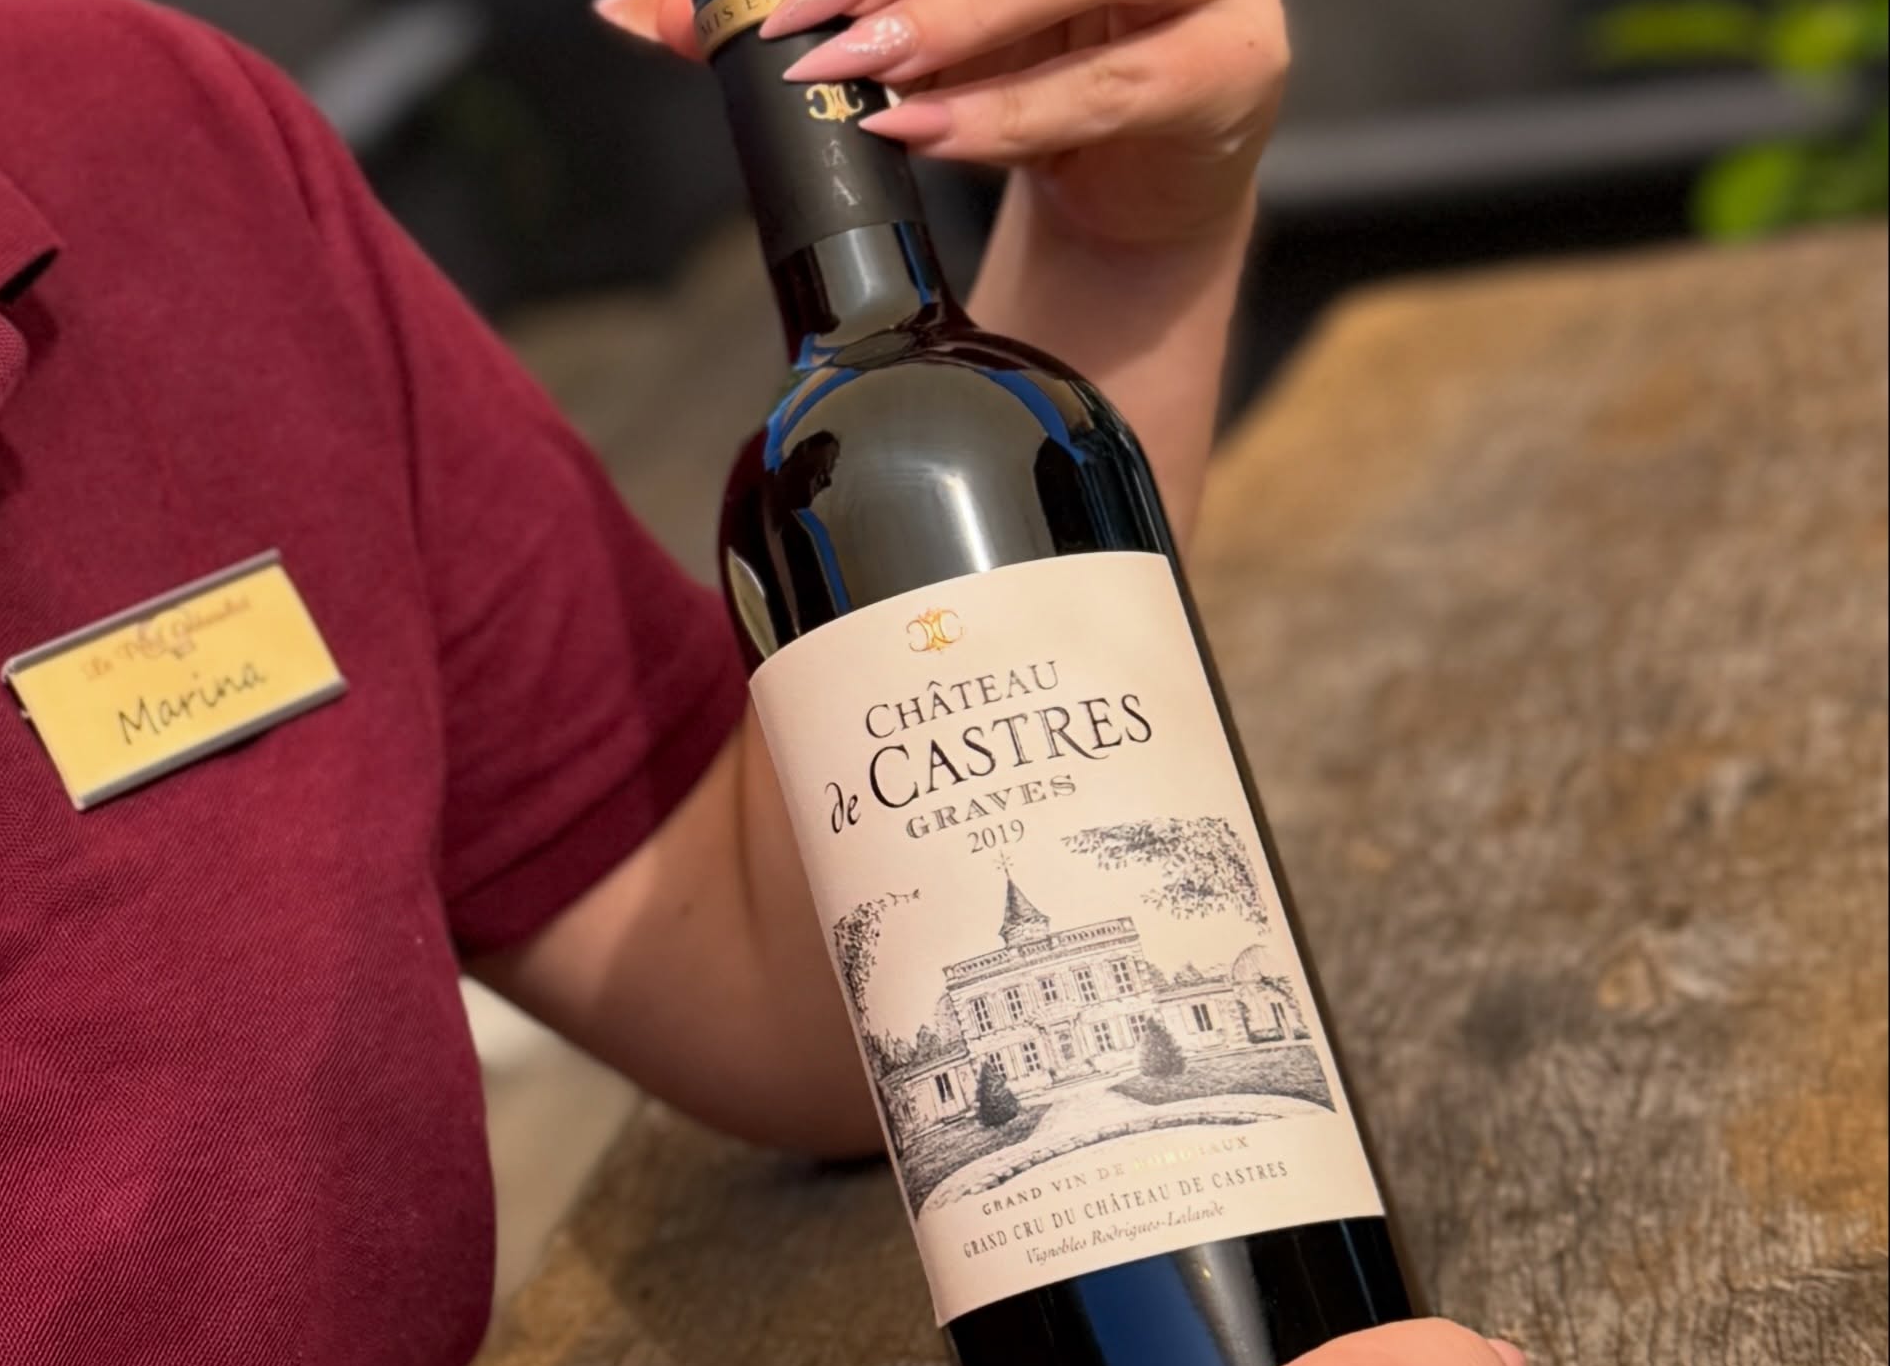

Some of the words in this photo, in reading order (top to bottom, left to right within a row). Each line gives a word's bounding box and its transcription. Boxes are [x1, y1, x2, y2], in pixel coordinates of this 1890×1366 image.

[701, 7, 735, 36] MIS
[118, 662, 266, 745] Marina
[864, 660, 1059, 739] CHÂTEAU
[823, 781, 861, 835] de
[868, 693, 1152, 809] CASTRES
[905, 773, 1077, 839] GRAVES
[967, 819, 1025, 854] 2019
[962, 1230, 1008, 1259] GRAND
[1013, 1218, 1045, 1241] CRU
[1051, 1207, 1076, 1230] DU
[1083, 1183, 1170, 1220] CHÂTEAU
[1178, 1176, 1205, 1196] DE
[1212, 1160, 1289, 1189] CASTRES
[981, 1186, 1043, 1216] GRAND
[1051, 1171, 1088, 1193] VIN
[1096, 1162, 1126, 1182] DE
[1026, 1234, 1088, 1266] Vignobles
